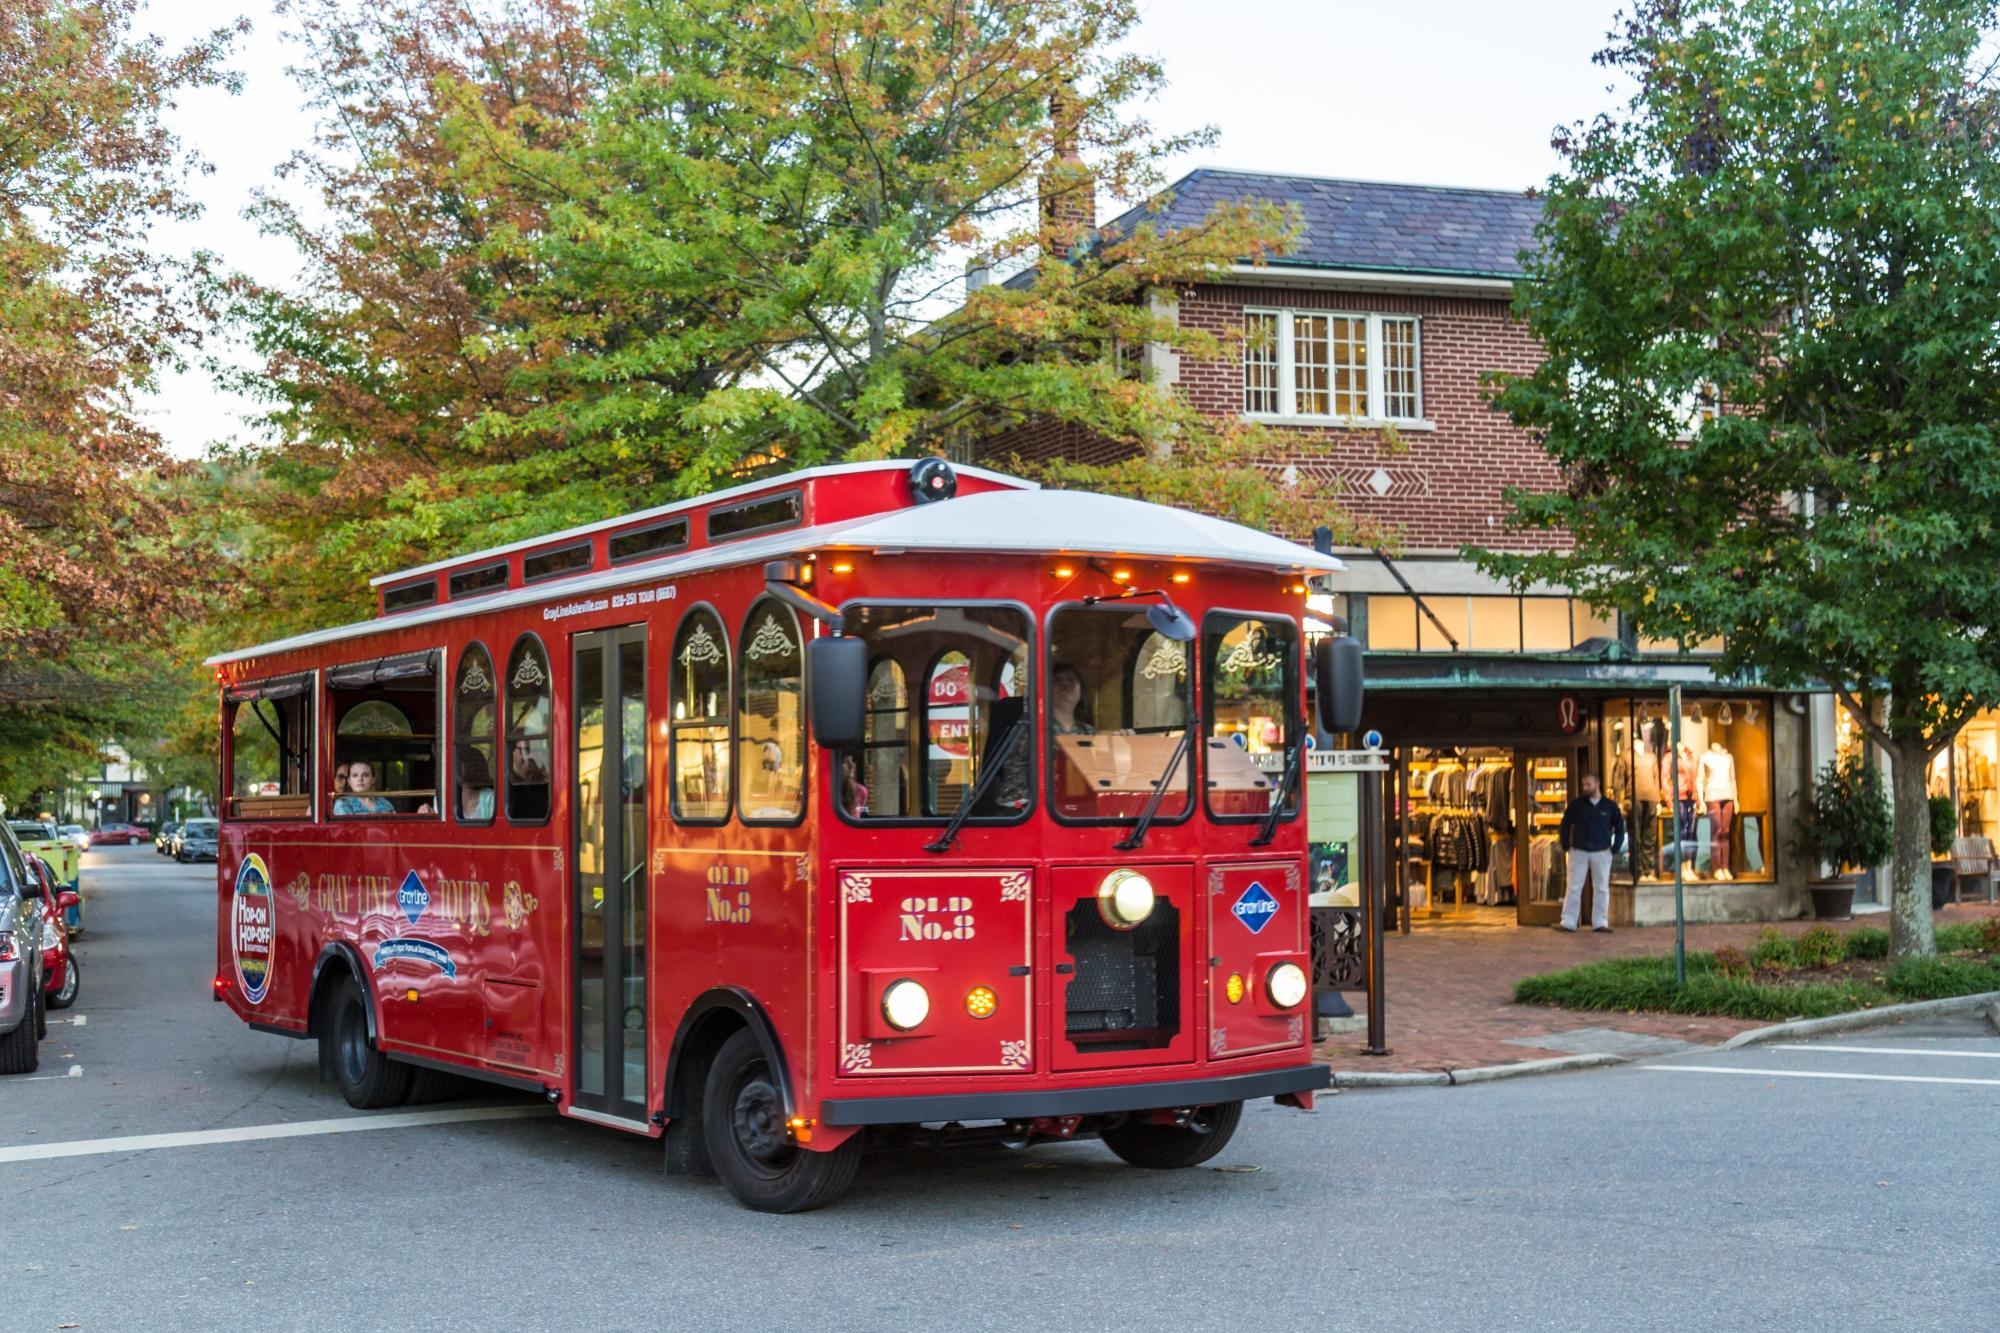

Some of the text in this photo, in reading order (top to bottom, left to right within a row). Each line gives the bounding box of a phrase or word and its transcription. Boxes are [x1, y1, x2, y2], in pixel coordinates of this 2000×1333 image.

[638, 589, 655, 603] TOUR
[934, 682, 957, 697] DO
[707, 865, 750, 885] OLD
[318, 873, 490, 936] GRAY LINE TOURS
[706, 888, 751, 923] No.8
[901, 897, 973, 912] OLD
[899, 914, 976, 941] No.8
